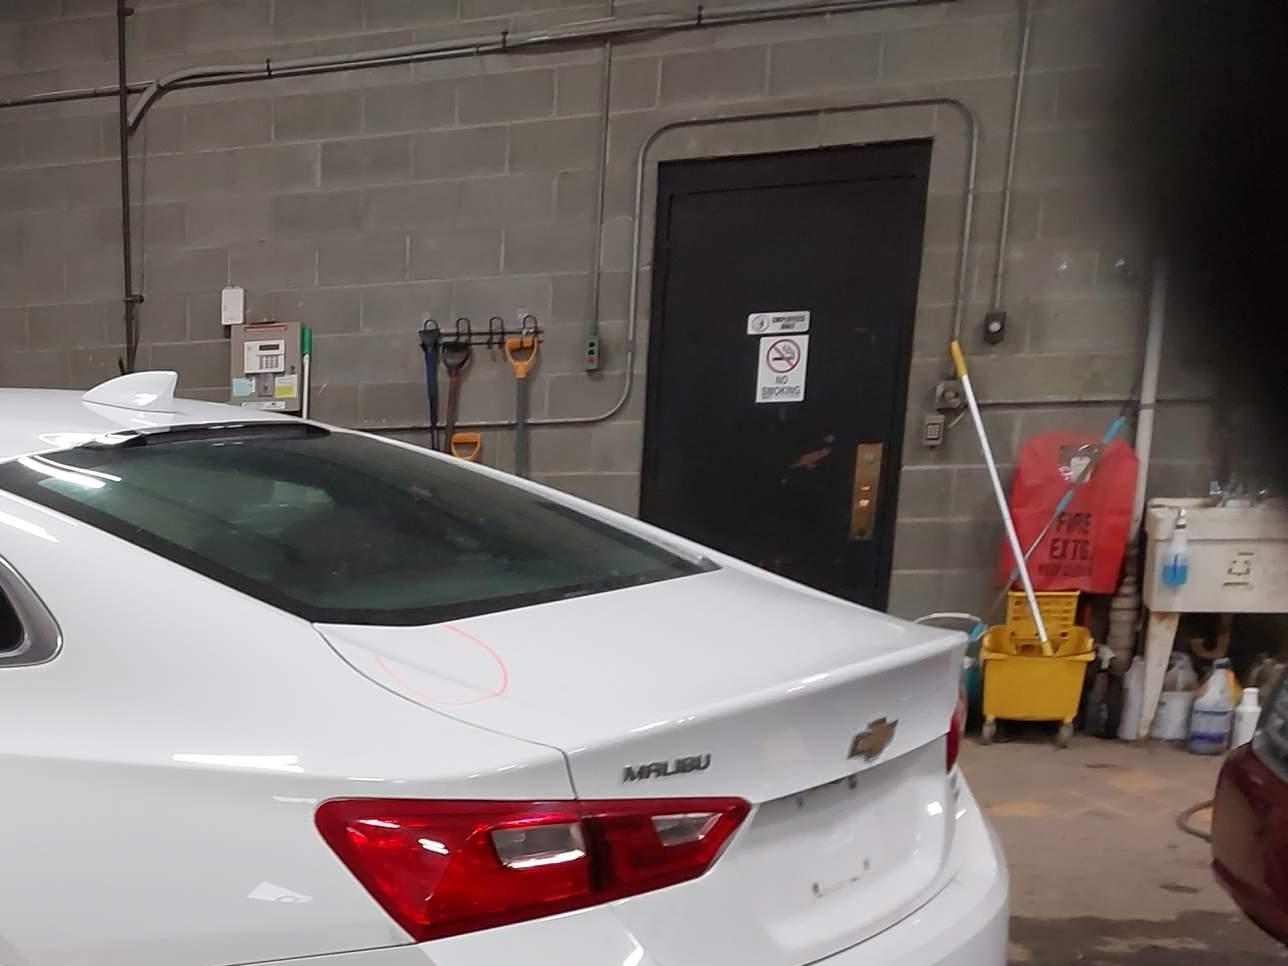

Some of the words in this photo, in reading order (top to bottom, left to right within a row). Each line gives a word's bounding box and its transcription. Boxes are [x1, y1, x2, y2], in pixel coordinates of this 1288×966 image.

[776, 375, 788, 384] NO
[1056, 512, 1092, 534] FIRE
[622, 753, 712, 783] MALIBU
